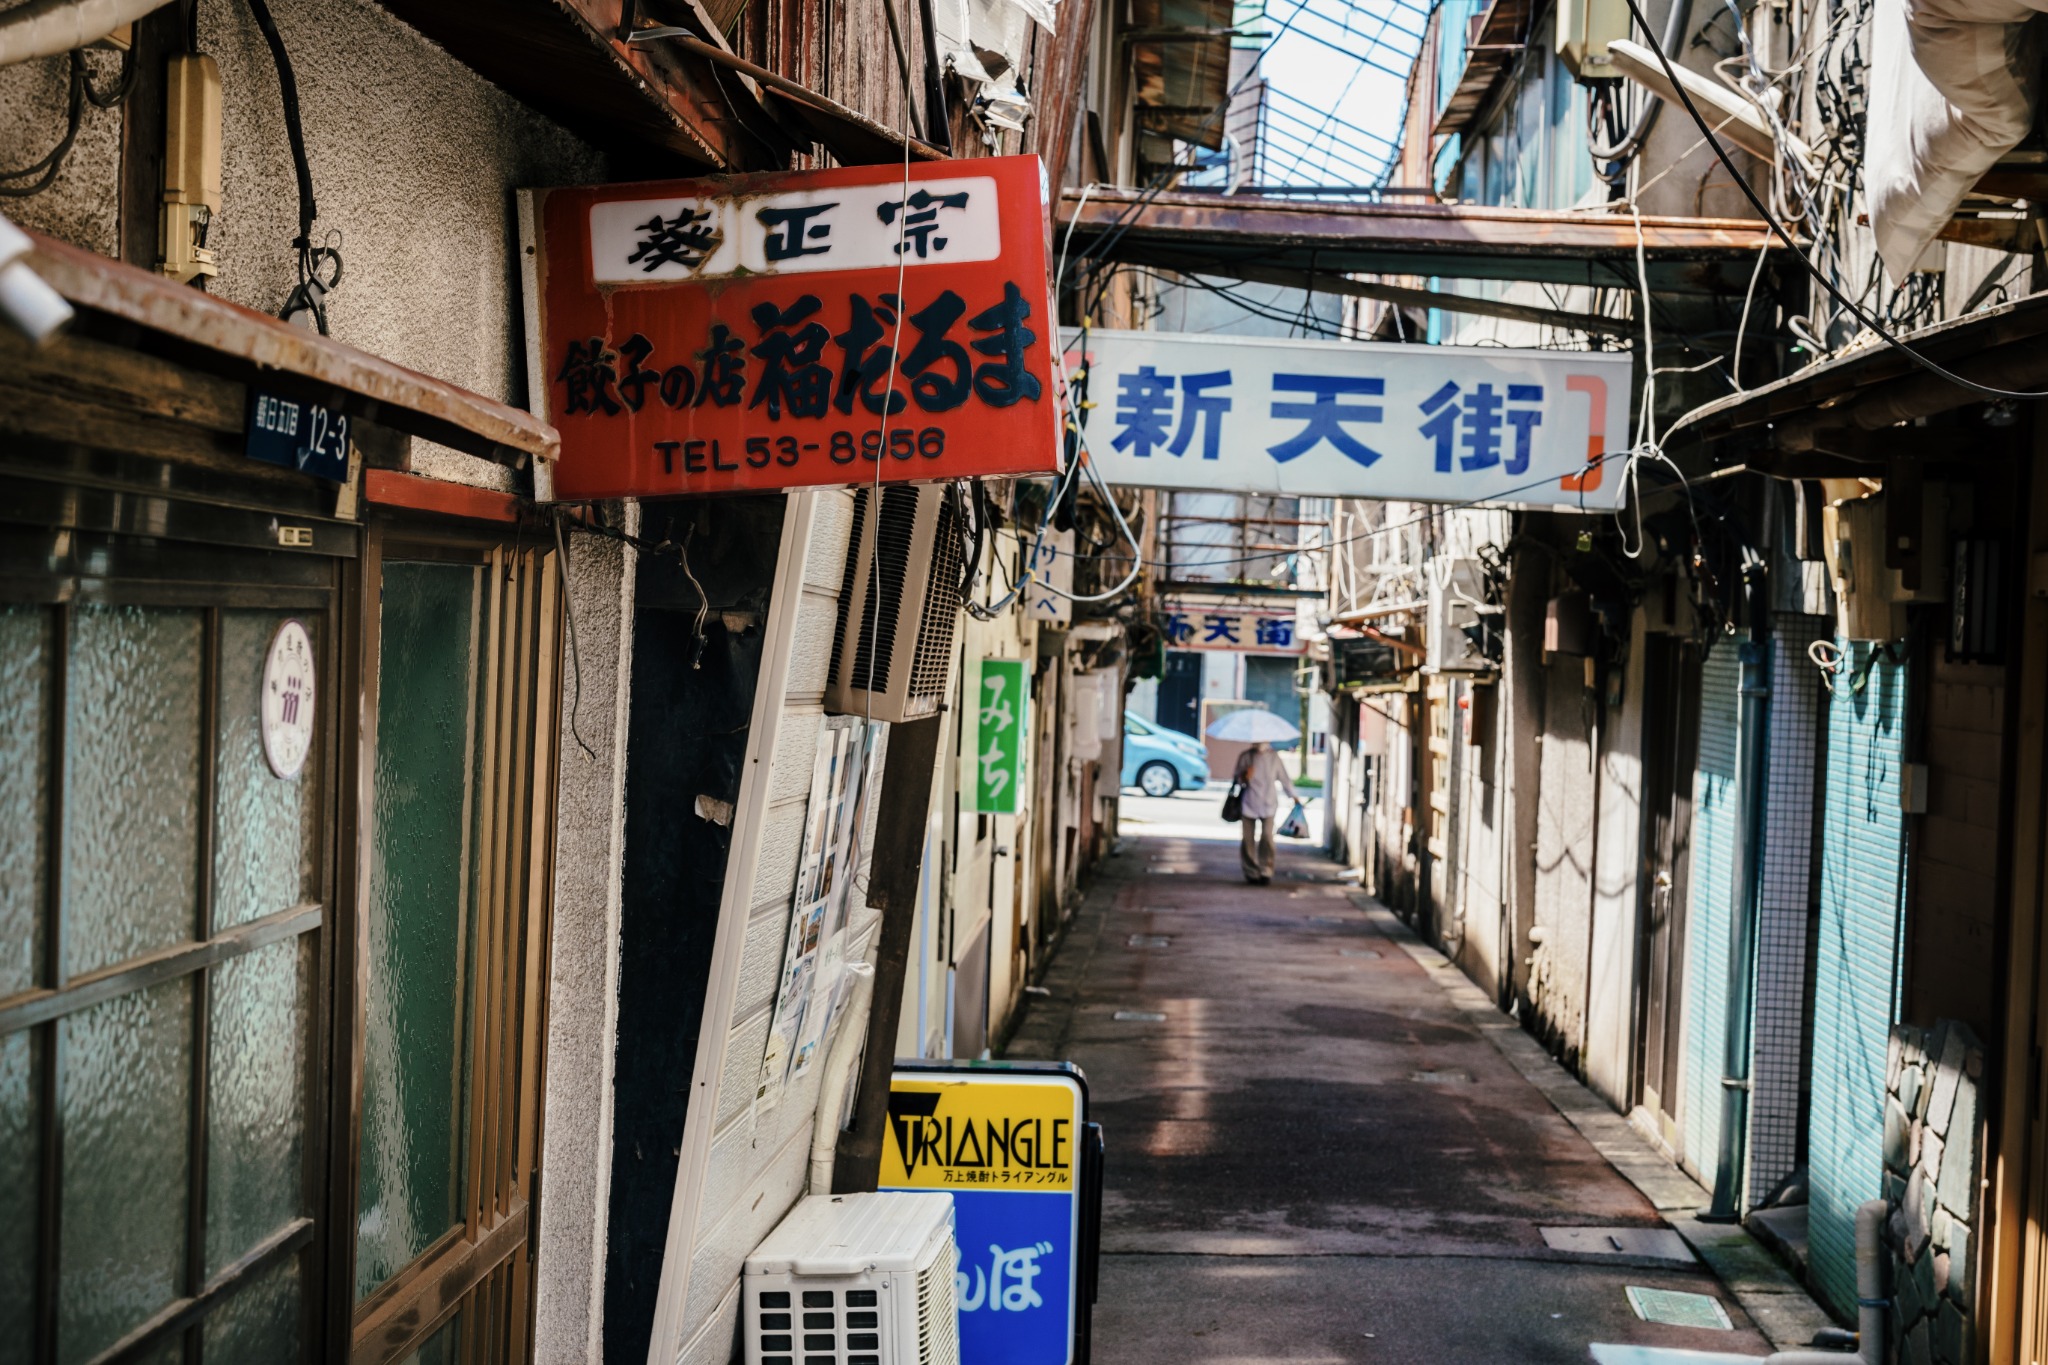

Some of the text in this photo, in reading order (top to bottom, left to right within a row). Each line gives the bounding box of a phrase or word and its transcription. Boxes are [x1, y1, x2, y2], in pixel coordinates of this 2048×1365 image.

[557, 281, 1041, 421] 餃子の店 福だるま
[310, 404, 347, 461] 12-3
[1111, 366, 1544, 475] 新天街
[979, 674, 1014, 798] みち
[899, 1115, 1069, 1168] TRIANGLE
[944, 1169, 1068, 1184] 万上焼酎トライアングル
